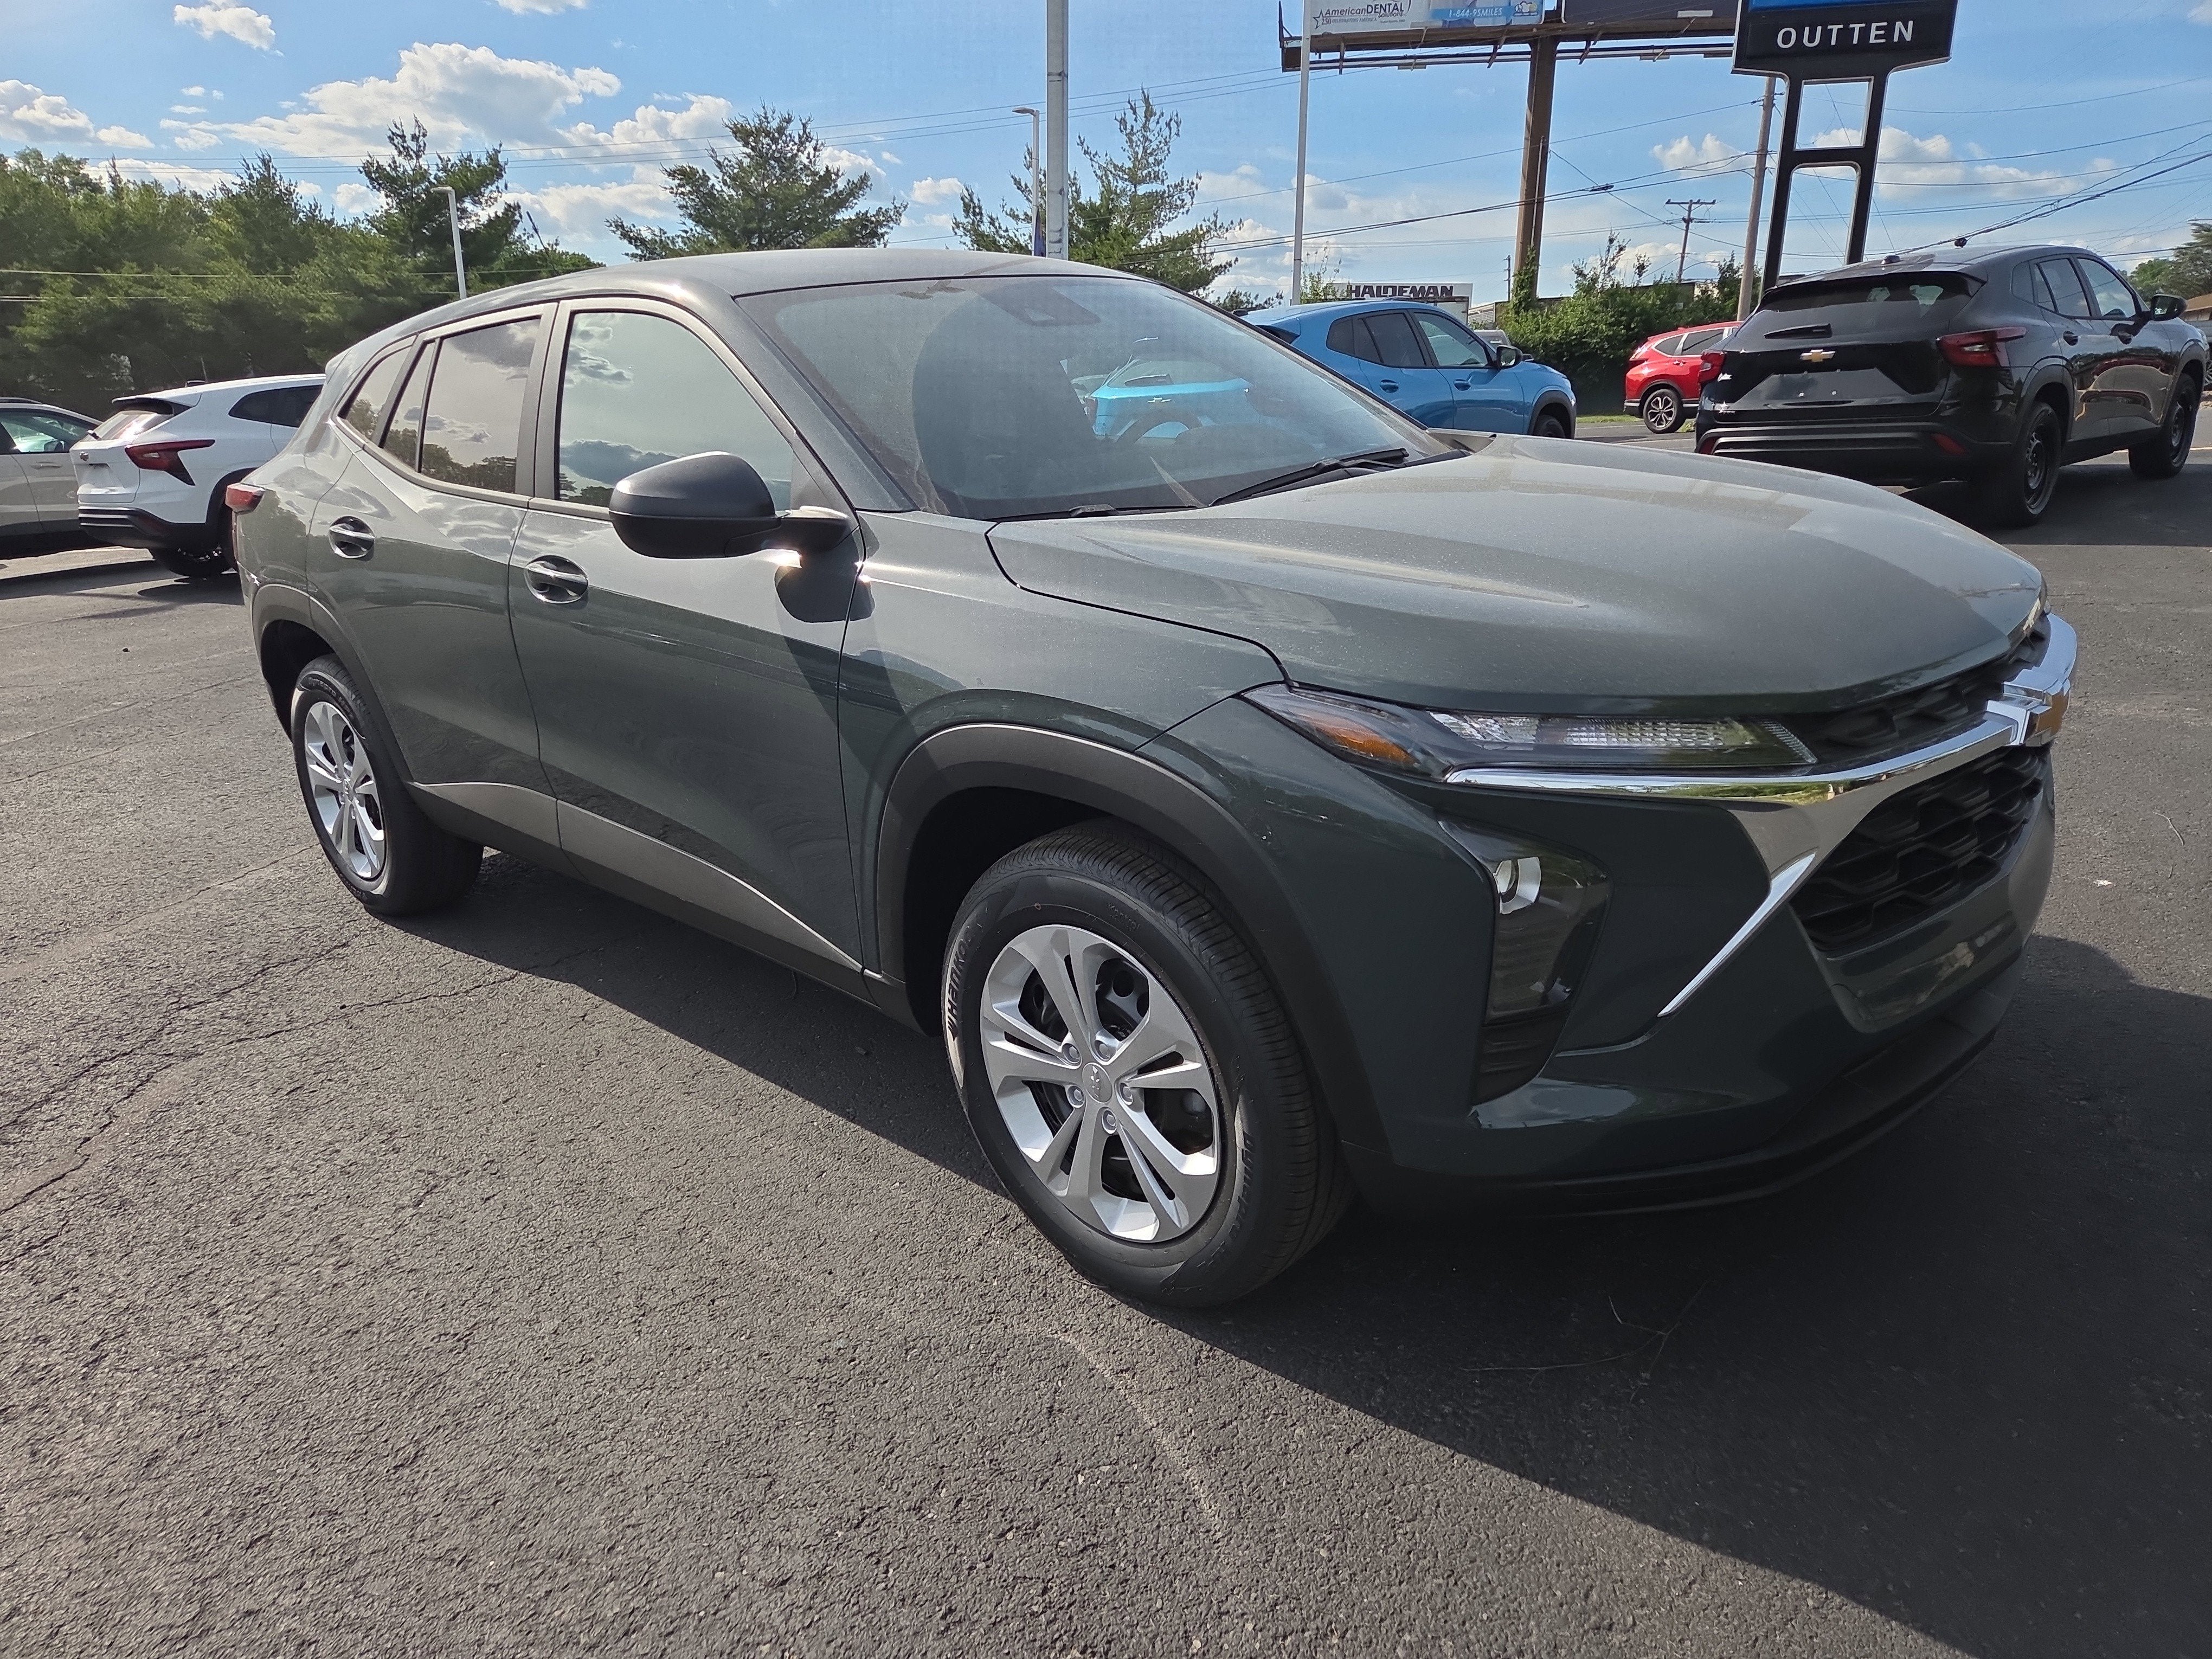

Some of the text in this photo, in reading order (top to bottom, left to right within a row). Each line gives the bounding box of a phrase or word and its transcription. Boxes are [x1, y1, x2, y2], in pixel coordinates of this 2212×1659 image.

[1449, 8, 1502, 18] 1-844-9SMILES
[1777, 20, 1914, 49] OUTTEN
[1348, 285, 1454, 298] HALDEMAN
